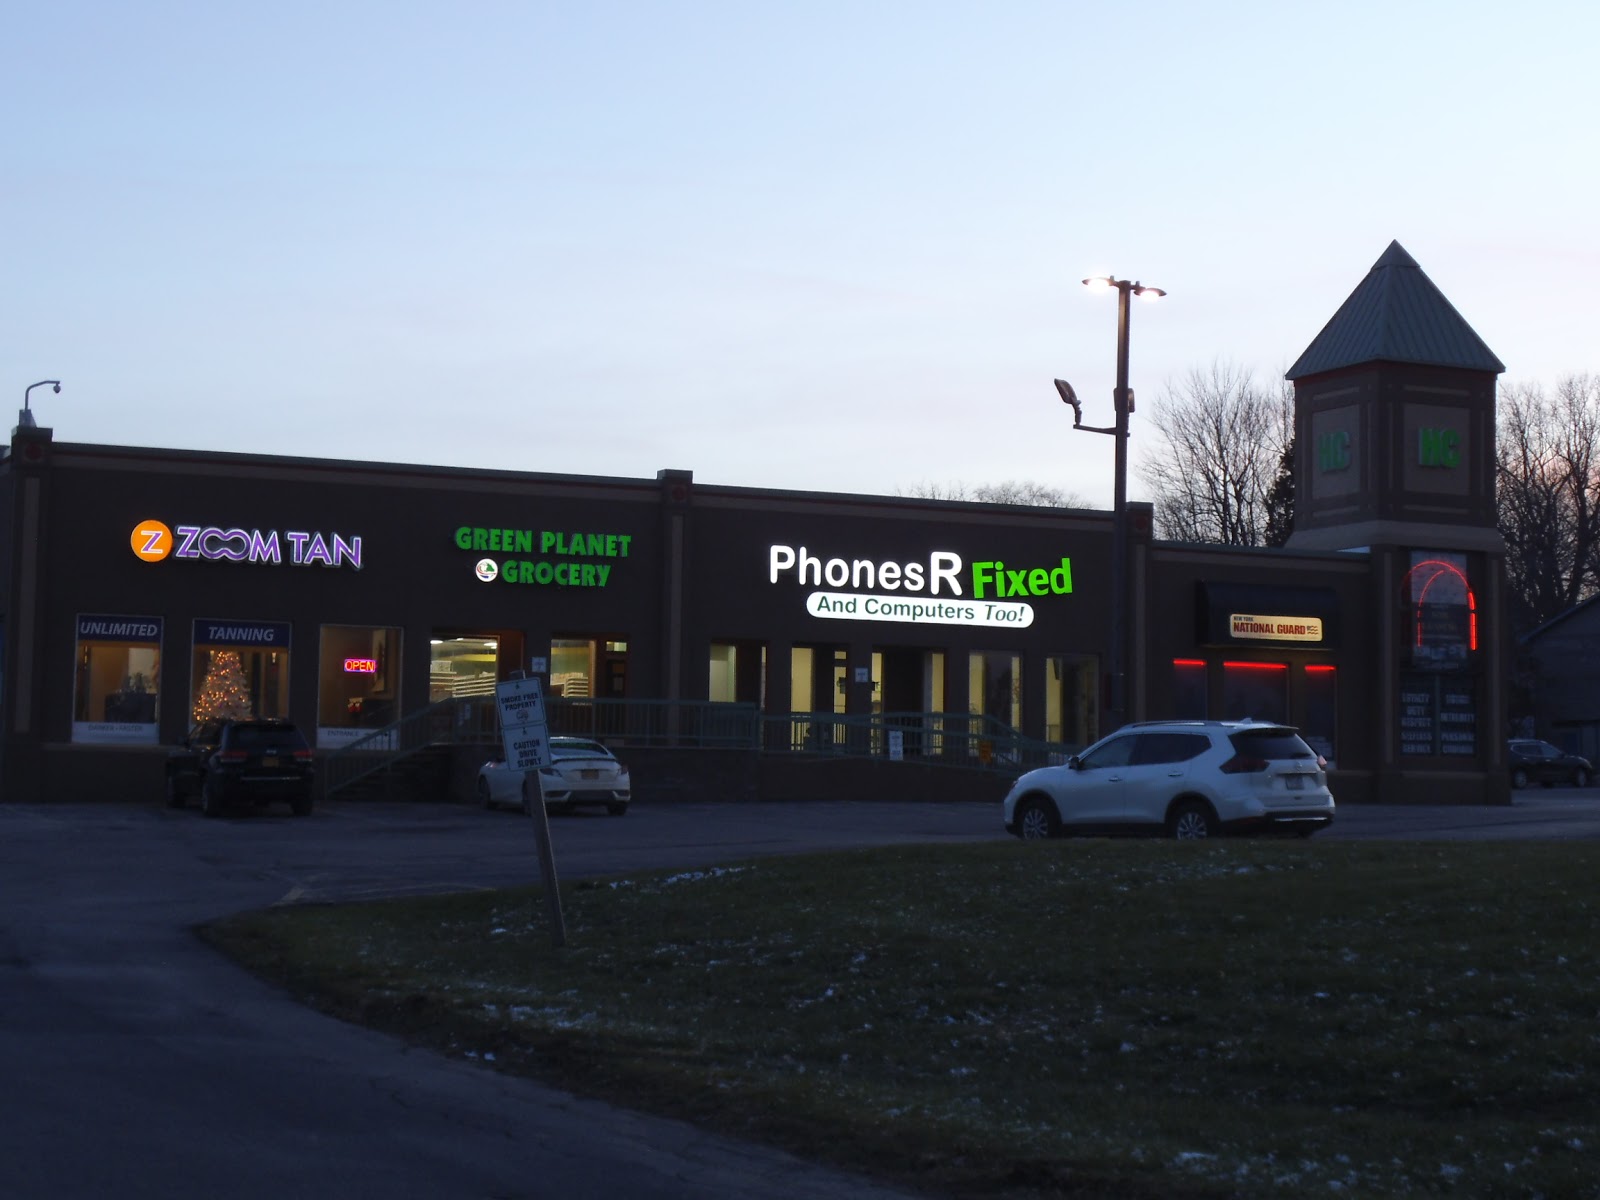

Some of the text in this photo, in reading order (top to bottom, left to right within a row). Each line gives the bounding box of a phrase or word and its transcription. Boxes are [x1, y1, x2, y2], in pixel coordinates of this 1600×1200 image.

[139, 526, 363, 570] Z ZOOM TAN
[455, 526, 632, 557] GREEN PLANET
[502, 560, 611, 588] GROCERY
[972, 557, 1074, 599] Fixed
[817, 595, 1025, 622] And Computers Too!
[80, 621, 158, 637] UNLIMITED
[208, 626, 275, 642] TANNING
[1233, 622, 1306, 635] NATIONAL GUARD
[345, 660, 375, 672] OPEN
[501, 696, 522, 704] SMOKE
[505, 700, 536, 711] PROPERTY
[513, 739, 540, 750] CAUTION
[519, 749, 538, 758] DRIVE
[517, 757, 542, 768] SLOWLY
